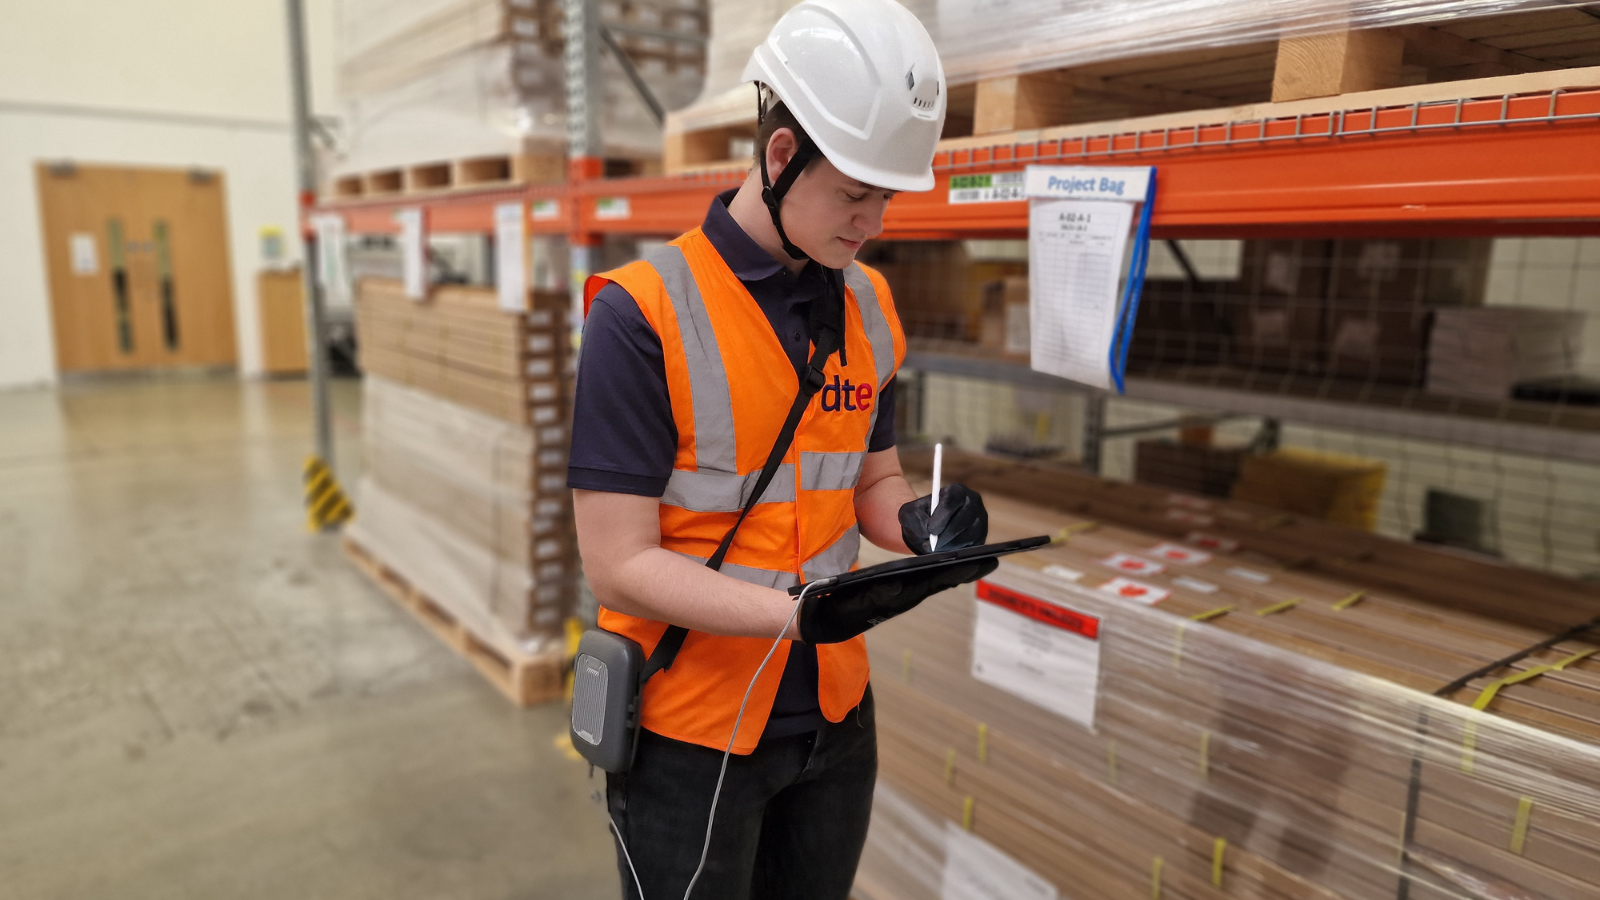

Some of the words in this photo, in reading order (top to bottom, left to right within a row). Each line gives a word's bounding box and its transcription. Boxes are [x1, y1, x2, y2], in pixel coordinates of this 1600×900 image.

[1047, 175, 1096, 194] Project
[1098, 177, 1125, 196] Bag
[821, 375, 873, 412] dte
